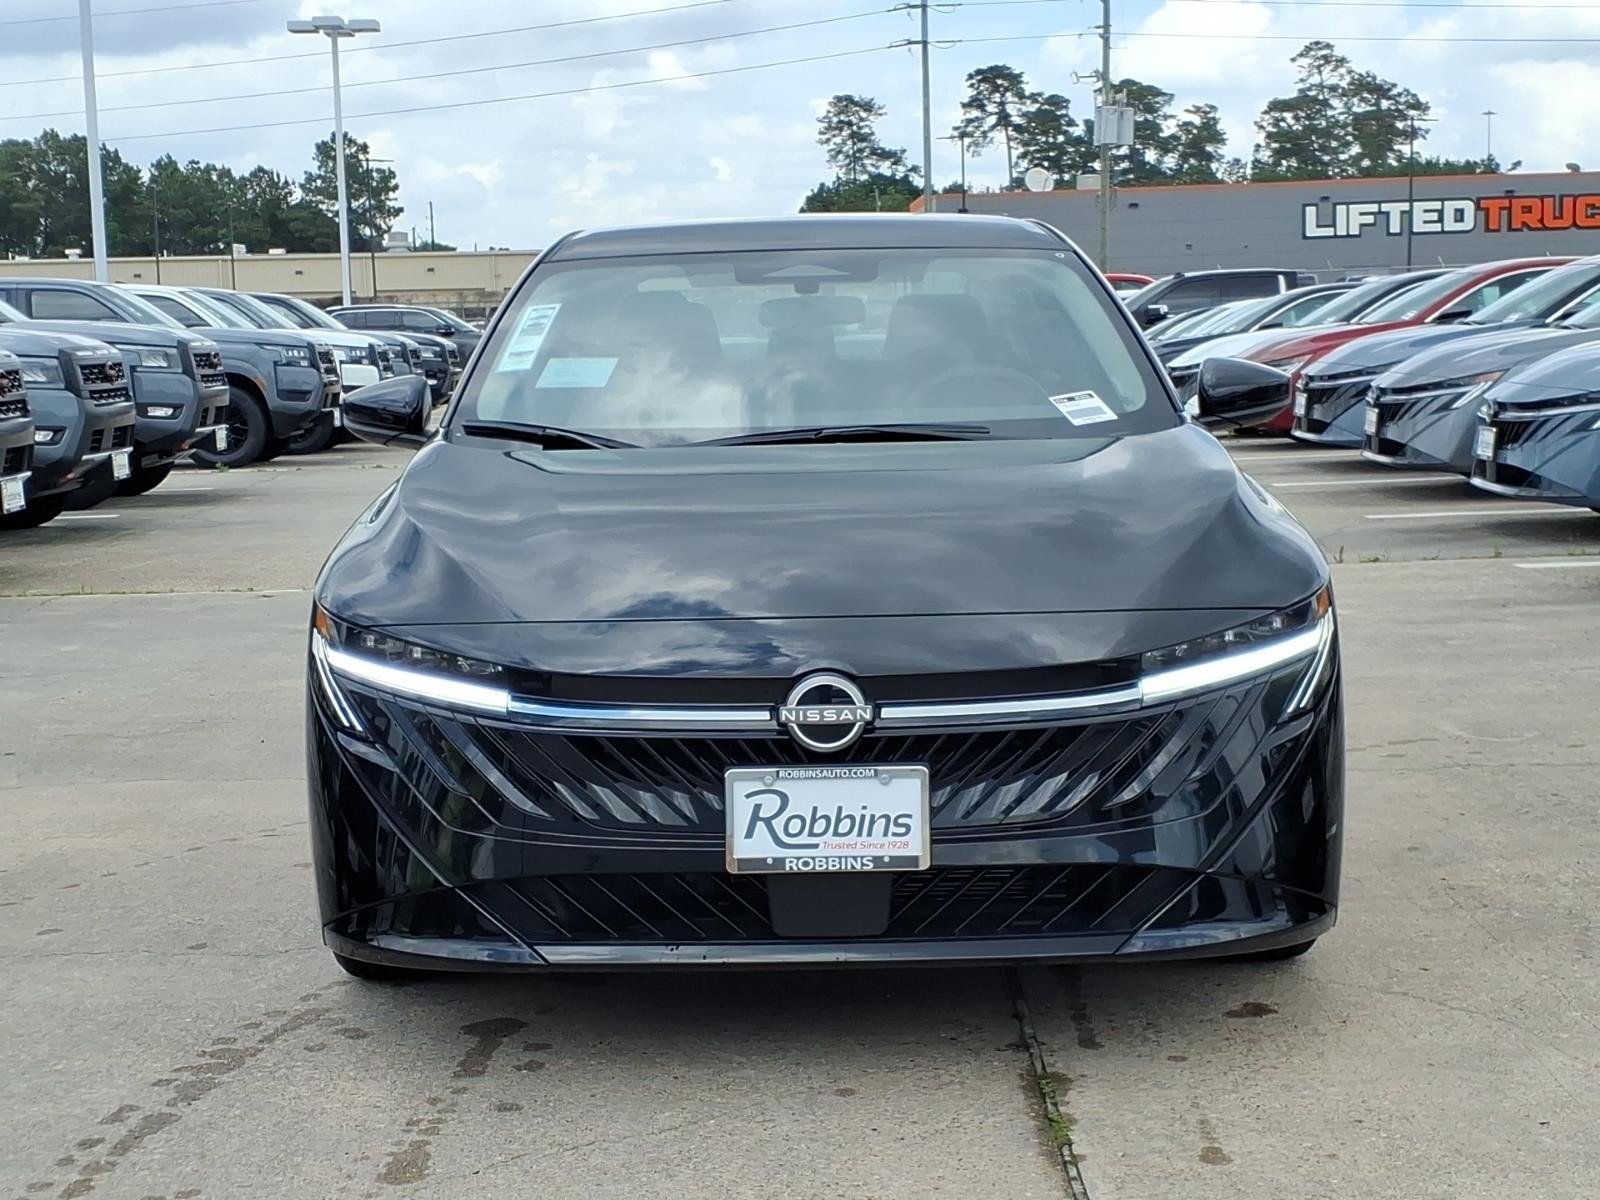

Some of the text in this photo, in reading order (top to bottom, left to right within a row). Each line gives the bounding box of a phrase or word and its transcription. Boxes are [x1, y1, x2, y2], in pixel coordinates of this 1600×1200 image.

[1303, 198, 1475, 238] LIFTED
[781, 708, 871, 721] NISSAN
[778, 769, 875, 780] ROBBINSAUTO.COM
[743, 788, 913, 850] Robbins
[823, 840, 909, 850] Trusted Since 1928
[785, 857, 874, 871] ROBBINS
